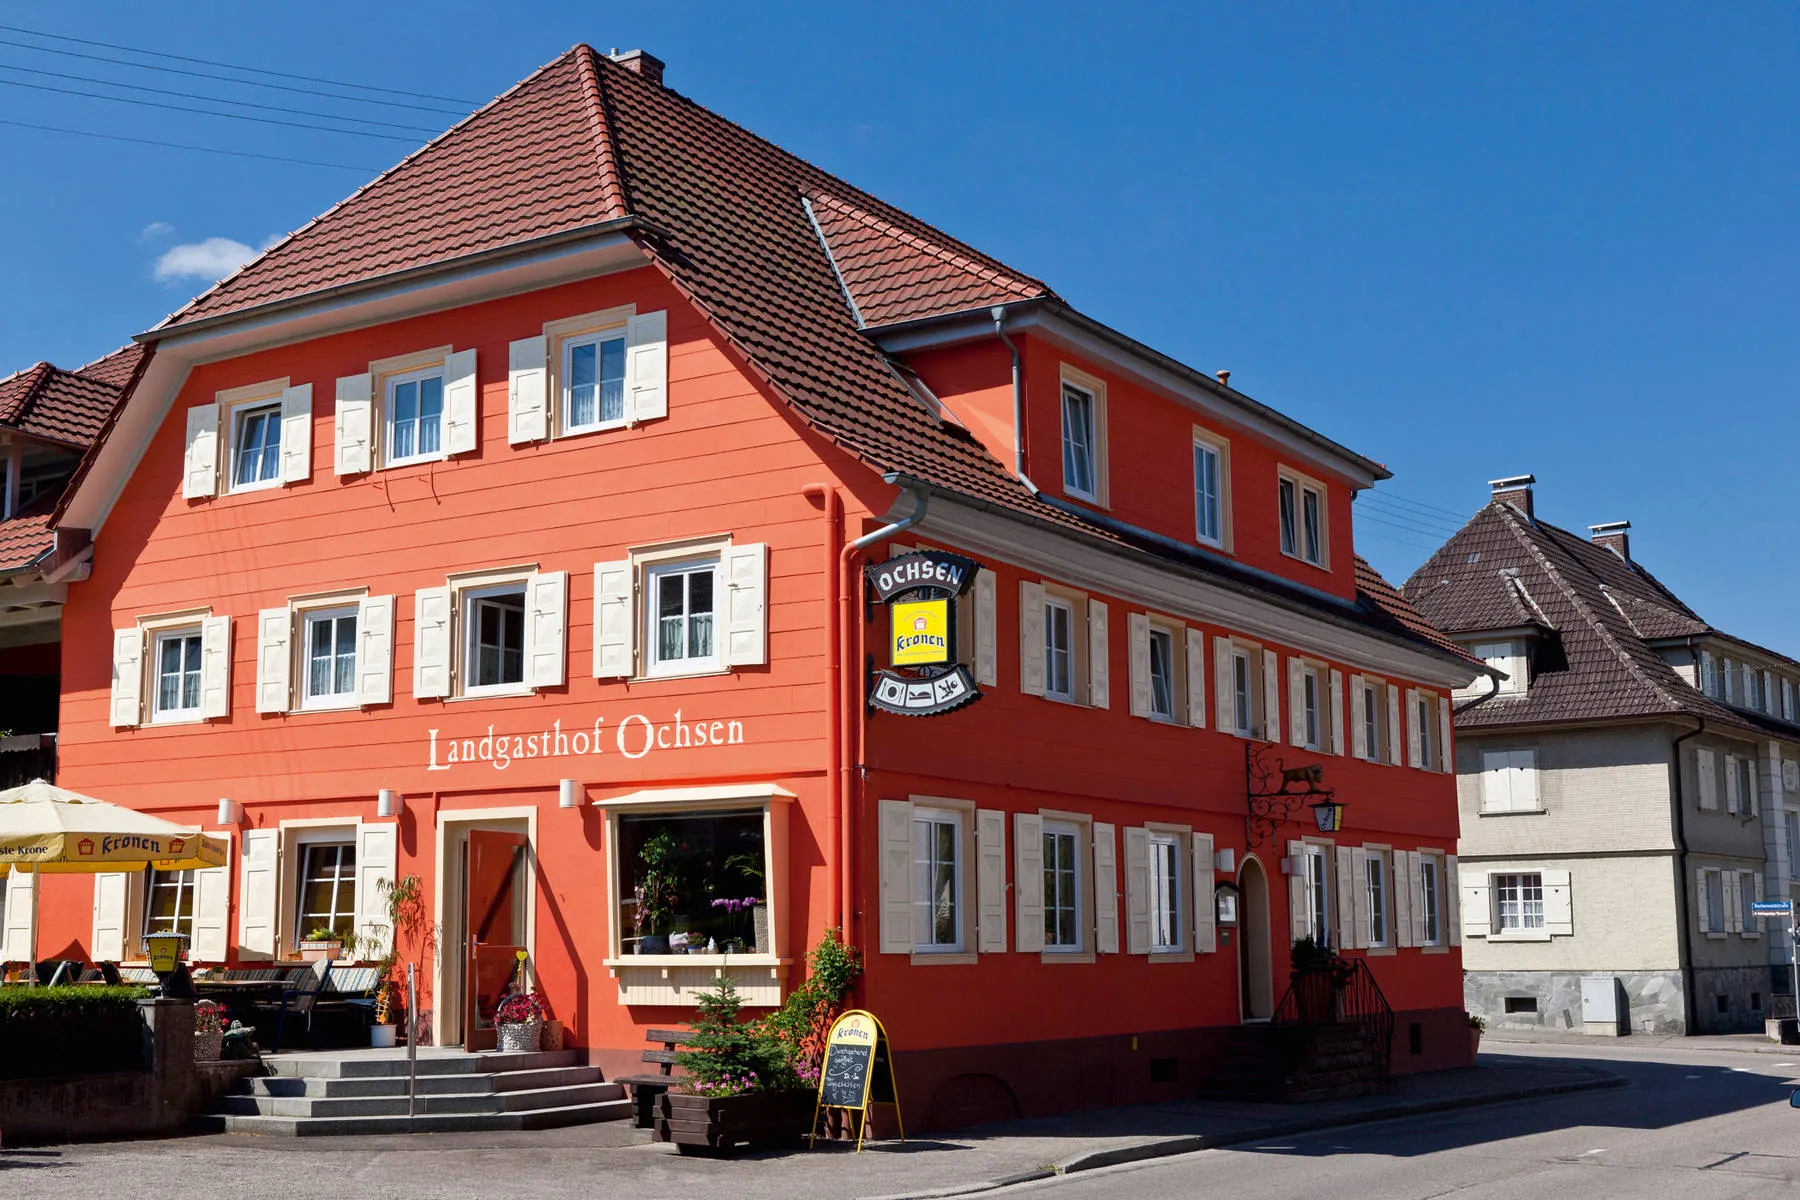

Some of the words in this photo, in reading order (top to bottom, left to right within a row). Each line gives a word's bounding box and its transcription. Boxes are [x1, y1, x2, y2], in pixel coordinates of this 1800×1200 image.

[878, 560, 963, 592] OCHSEN
[427, 716, 605, 771] Landgasthof
[616, 708, 745, 759] Ochsen
[17, 845, 49, 855] Krone
